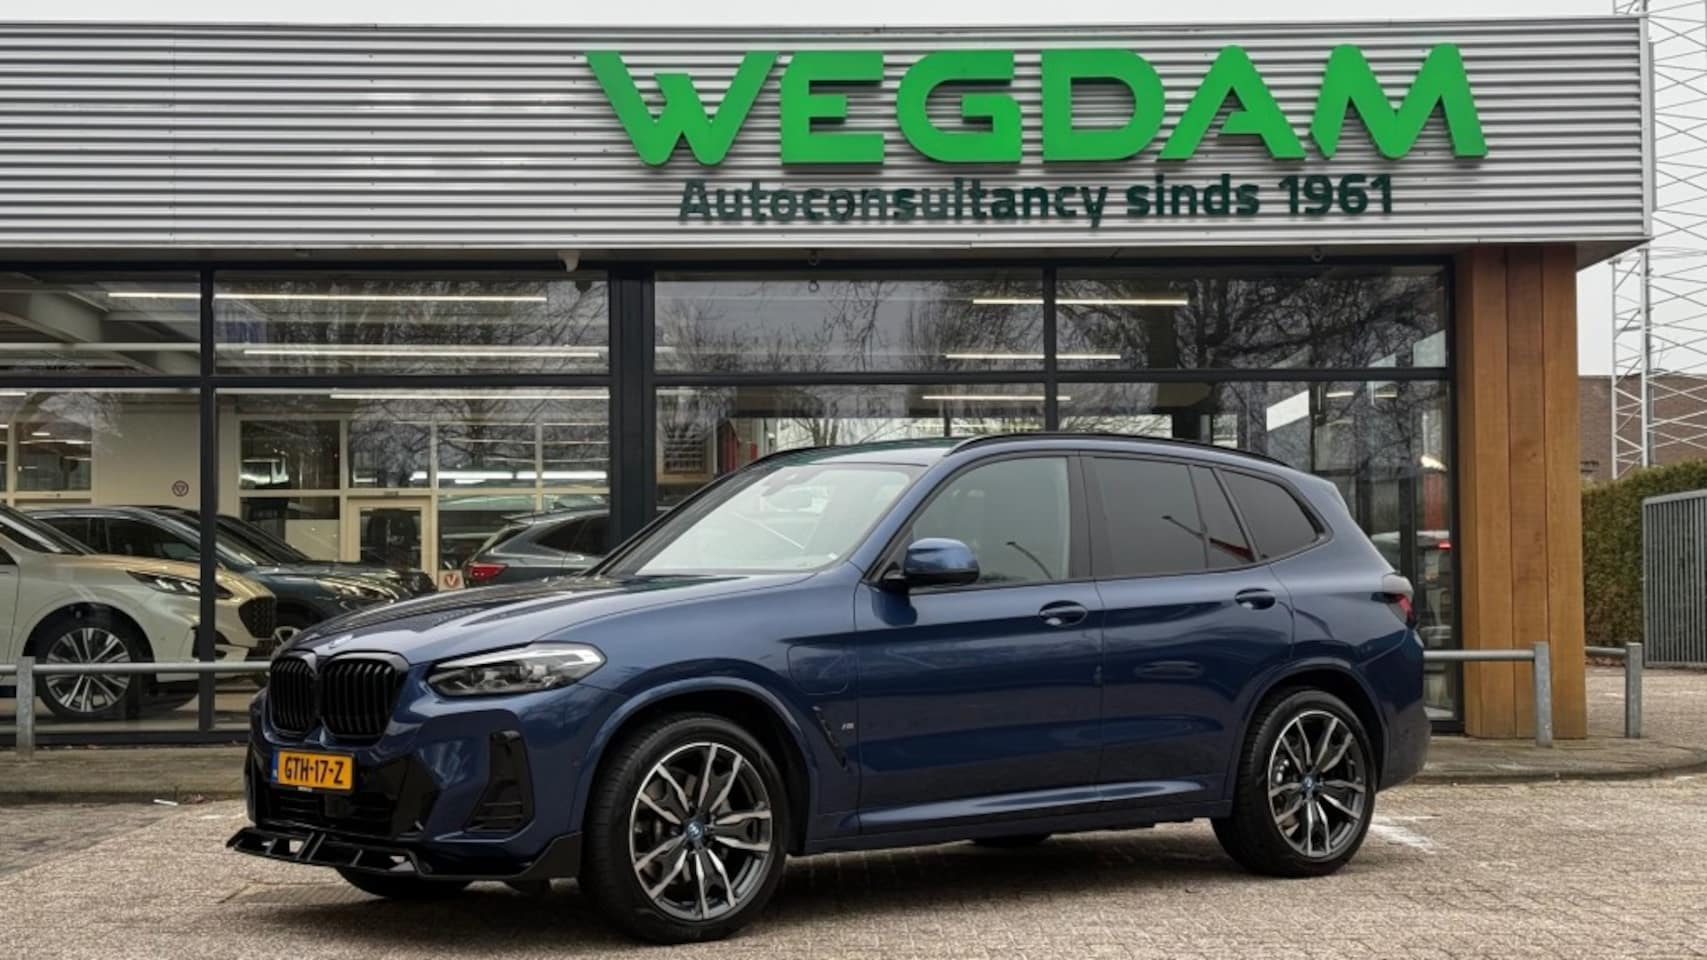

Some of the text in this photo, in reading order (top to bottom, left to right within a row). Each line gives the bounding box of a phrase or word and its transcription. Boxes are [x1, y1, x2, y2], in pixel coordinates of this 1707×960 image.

[584, 43, 1489, 165] WEGDAM
[679, 173, 1393, 229] Autoconsultancy sinds 1961
[284, 755, 345, 785] GTH-17-Z
